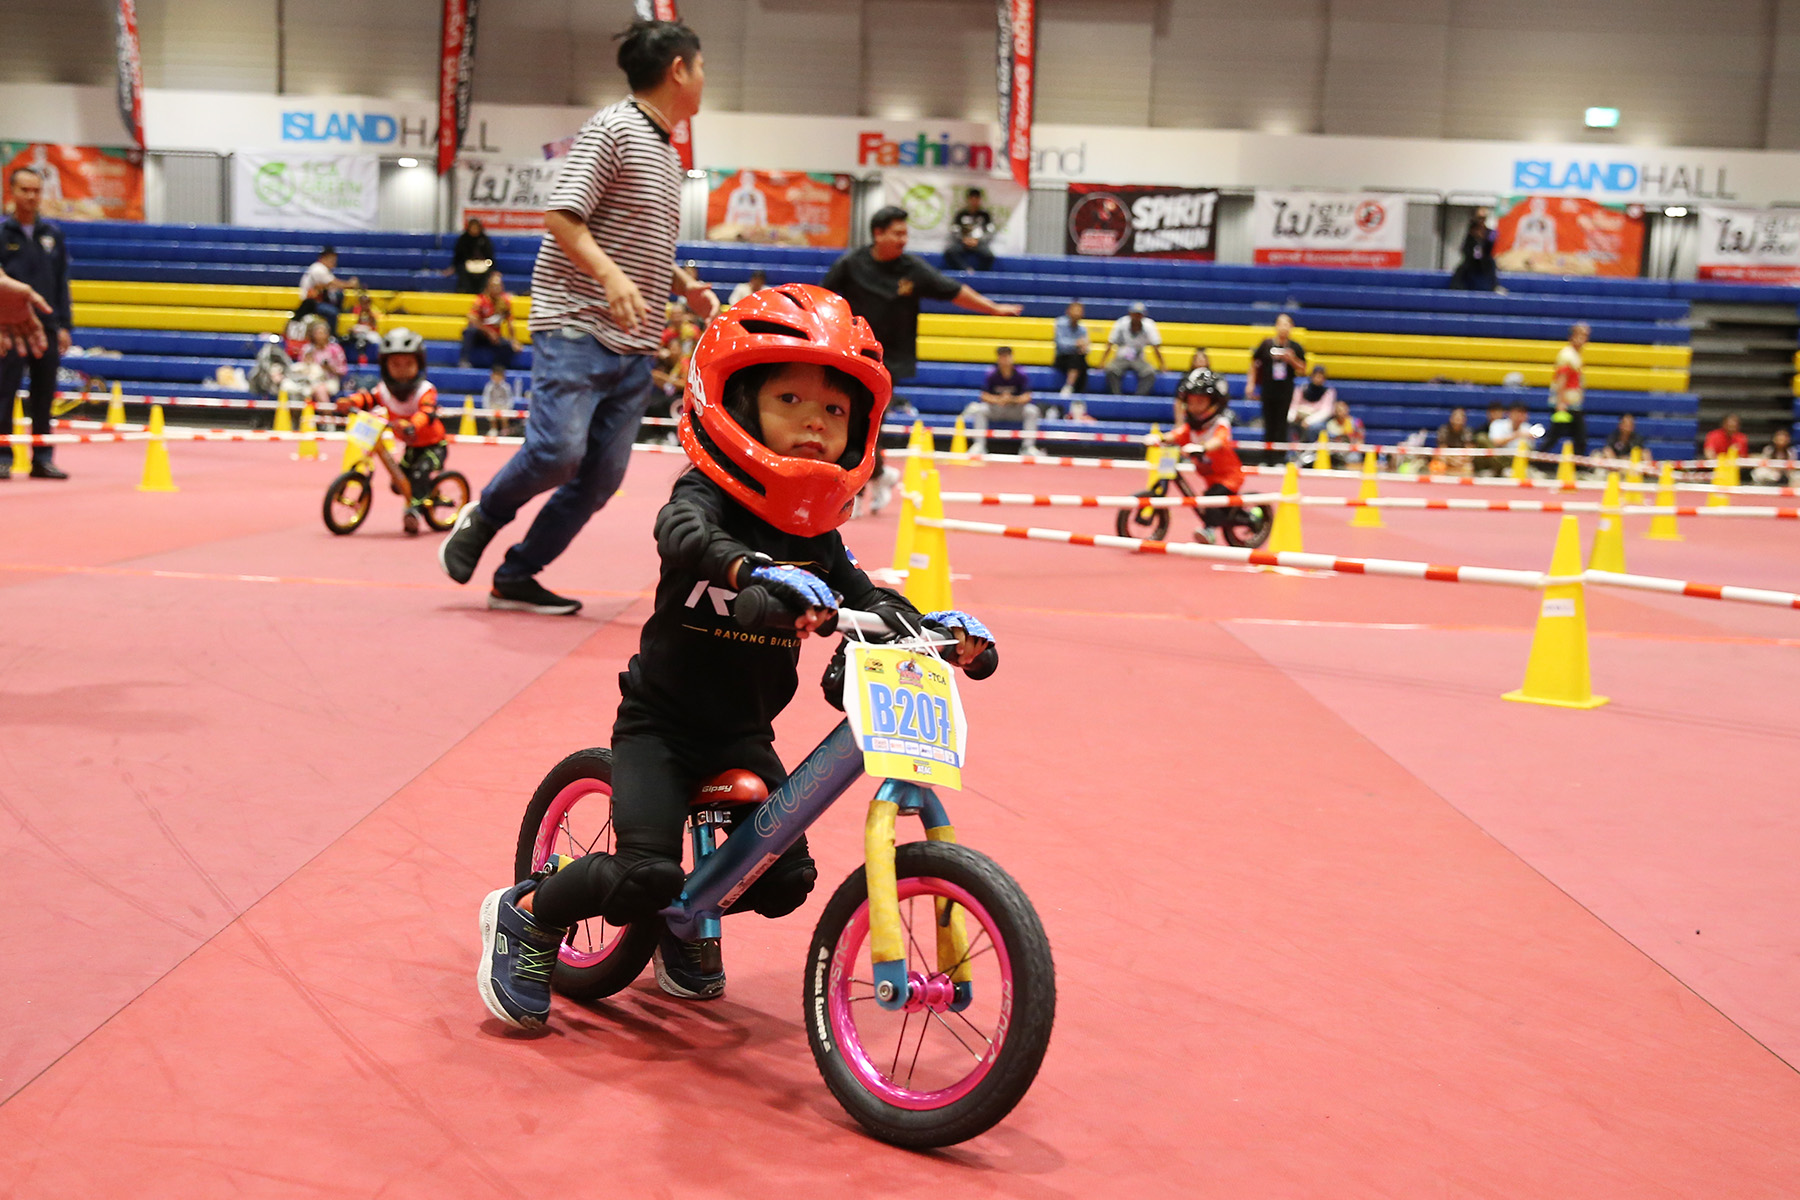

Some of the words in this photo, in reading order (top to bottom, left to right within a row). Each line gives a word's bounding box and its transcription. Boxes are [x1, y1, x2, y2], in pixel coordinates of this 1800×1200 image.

[282, 112, 398, 143] ISLAND
[858, 132, 993, 171] Fashion
[1513, 159, 1638, 191] ISLAND
[1640, 164, 1738, 201] HALL
[713, 628, 766, 645] RAYONG
[868, 681, 951, 747] B207
